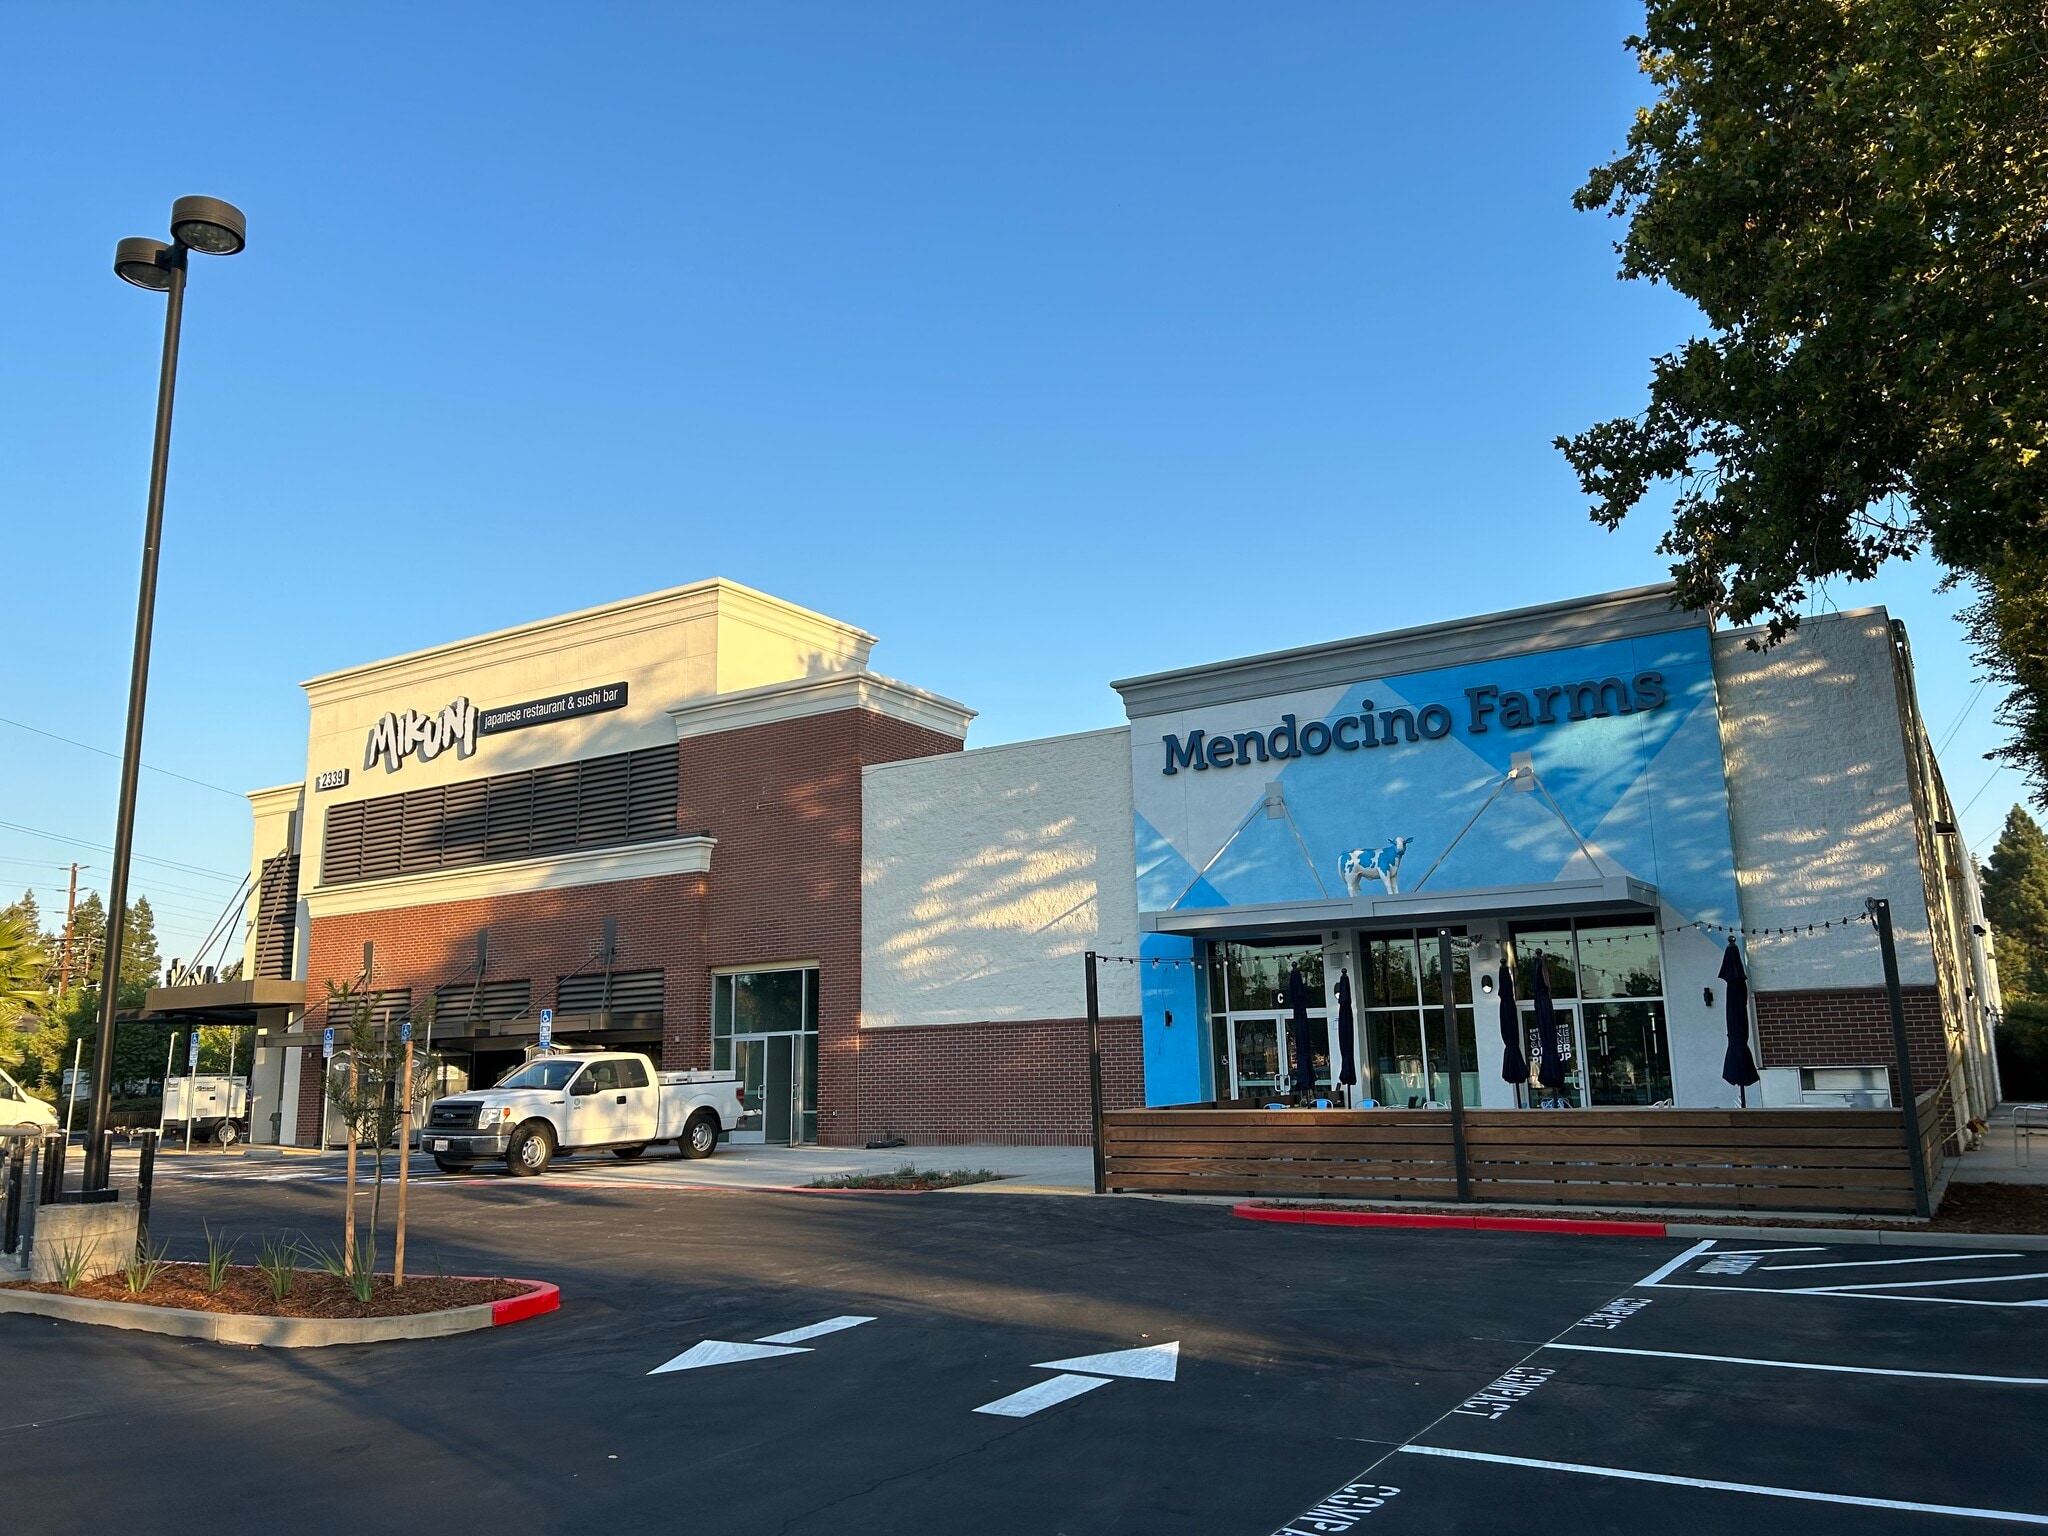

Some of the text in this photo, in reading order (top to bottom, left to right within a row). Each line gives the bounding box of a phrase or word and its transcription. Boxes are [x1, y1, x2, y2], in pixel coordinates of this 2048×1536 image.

[484, 688, 618, 730] japanese restaurant & sushi bar
[1162, 670, 1667, 775] Mendocino Farms
[368, 696, 478, 770] MIKUNI
[322, 770, 343, 787] 2339
[1577, 1298, 1653, 1329] COMPACT
[1454, 1367, 1556, 1419] COMPACT
